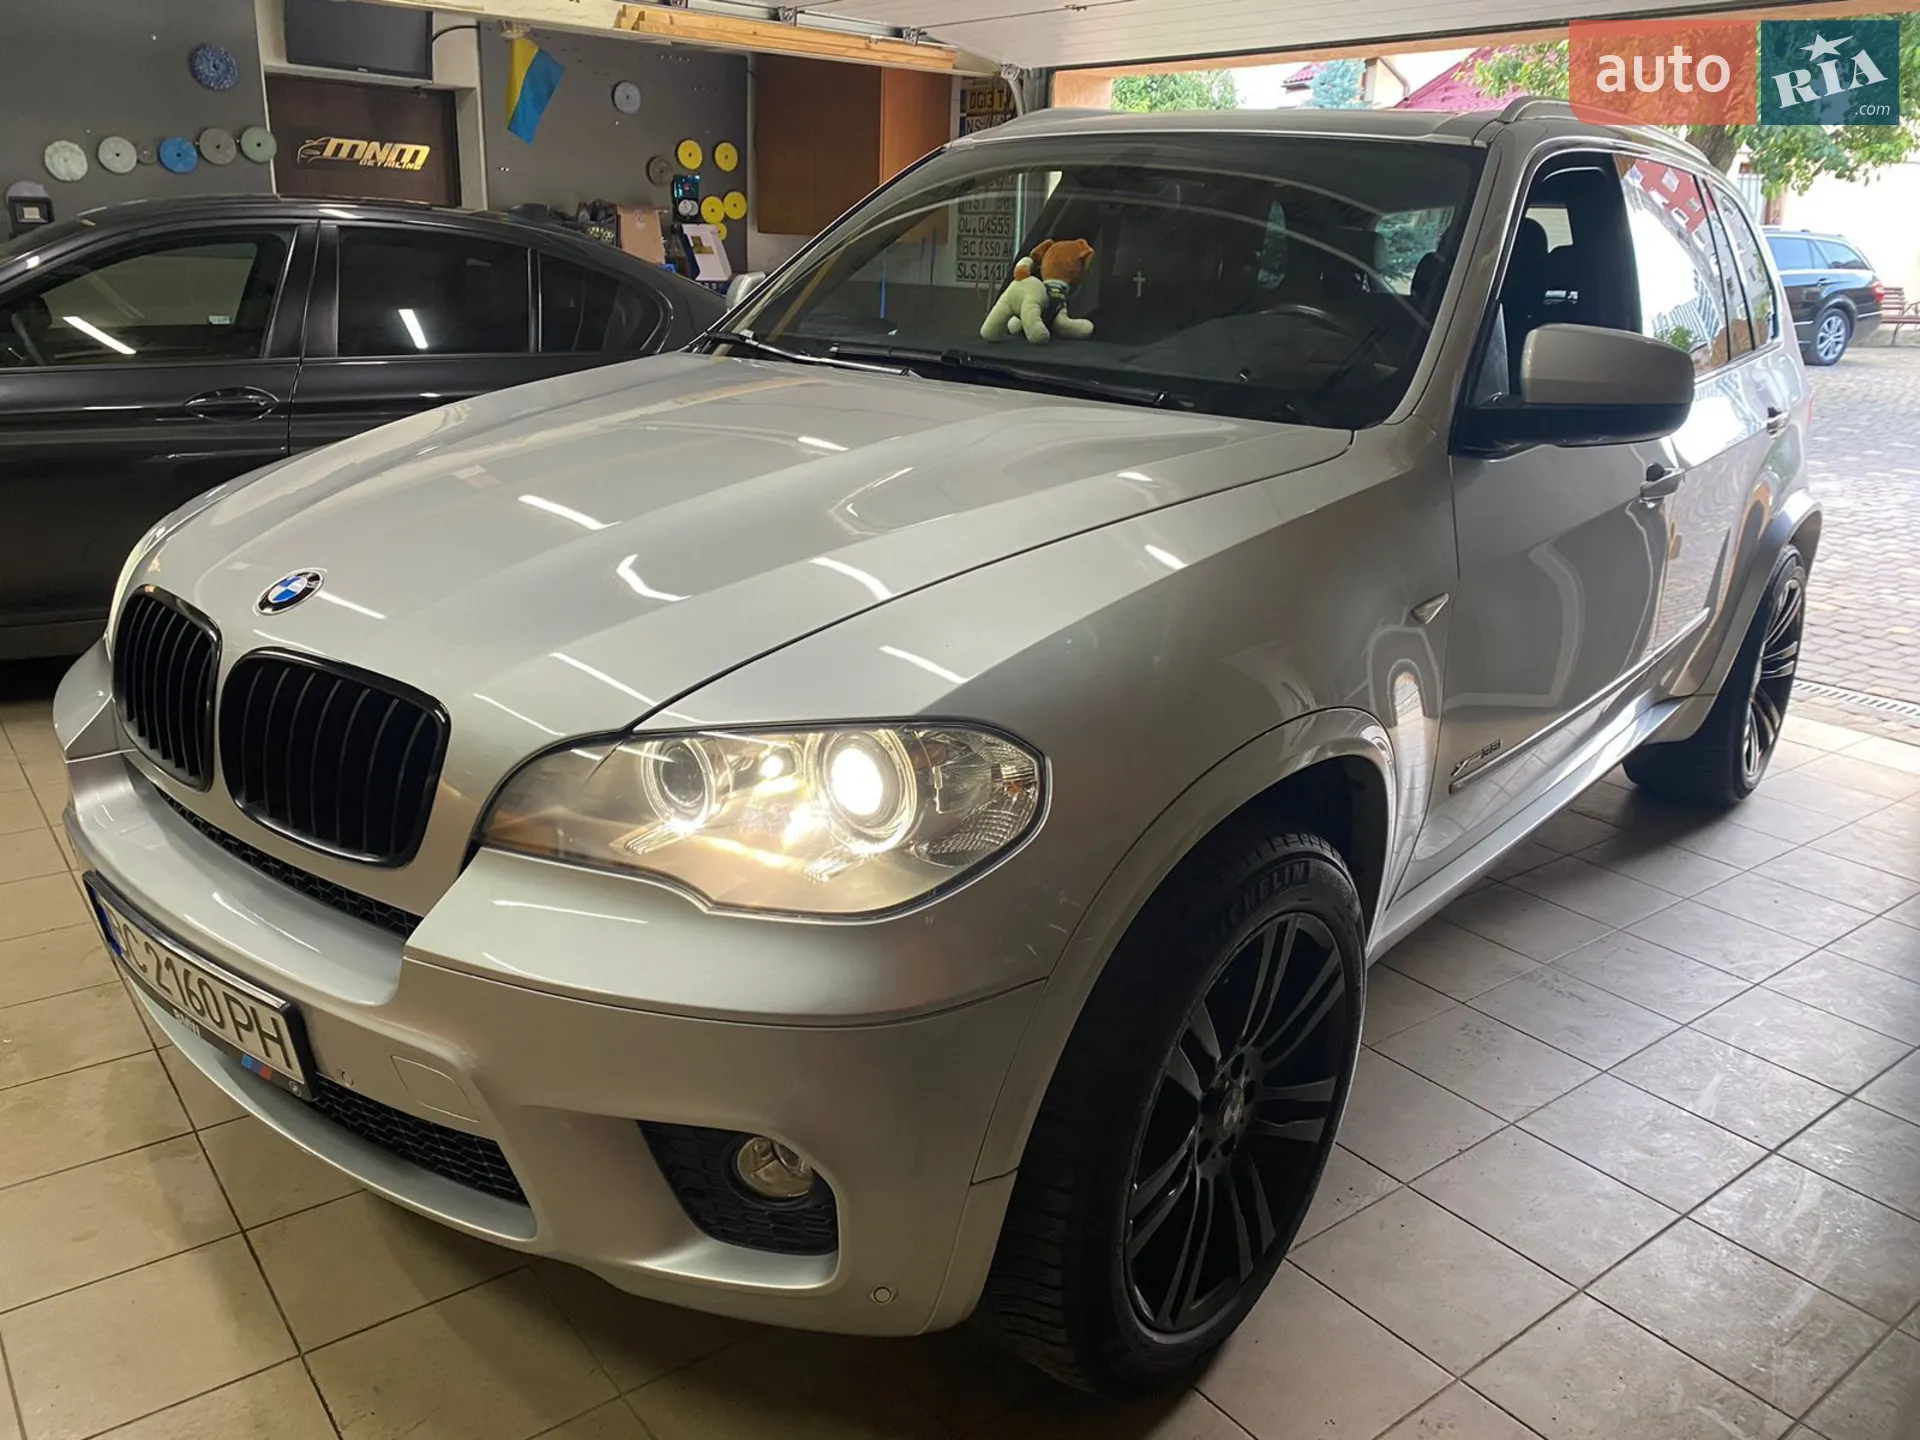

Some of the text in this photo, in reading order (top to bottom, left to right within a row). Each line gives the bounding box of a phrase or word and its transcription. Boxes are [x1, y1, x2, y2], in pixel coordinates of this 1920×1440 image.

[359, 160, 422, 171] DETAILING
[144, 941, 225, 1030] 2160
[222, 990, 293, 1071] PH
